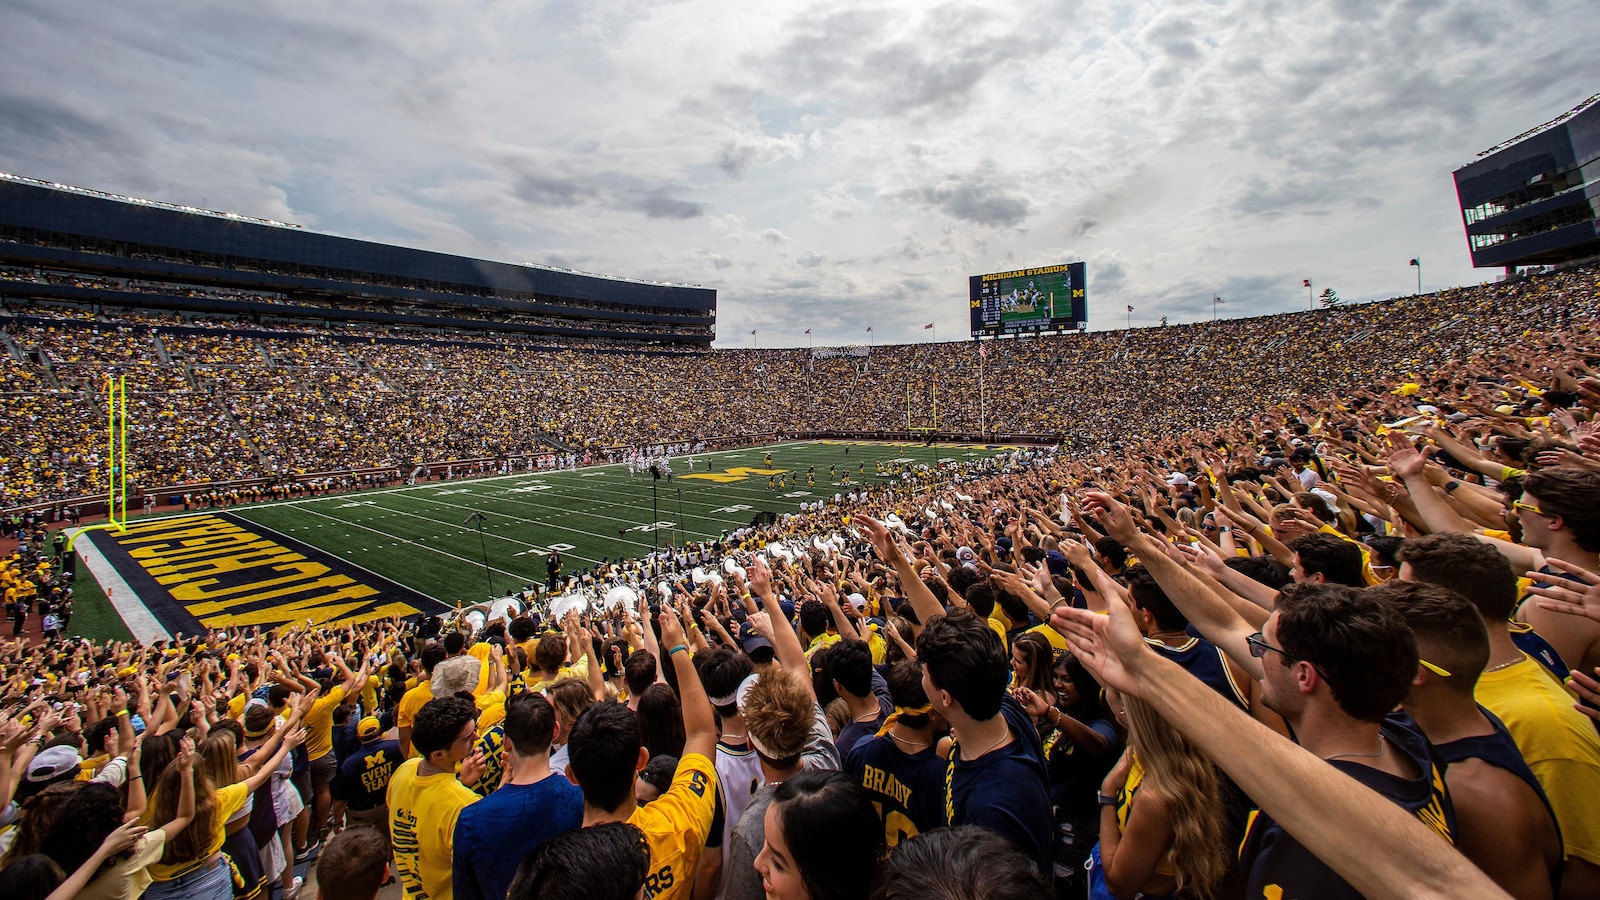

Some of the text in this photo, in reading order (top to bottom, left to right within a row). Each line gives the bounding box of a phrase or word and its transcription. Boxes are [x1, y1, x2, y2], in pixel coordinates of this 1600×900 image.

[982, 264, 1069, 281] MICHIGAN STADIUM
[1072, 289, 1084, 298] M
[970, 300, 981, 308] M
[104, 514, 421, 640] MICHIGAN
[364, 750, 386, 769] M
[361, 761, 393, 785] EVENT
[862, 763, 912, 809] BRADY
